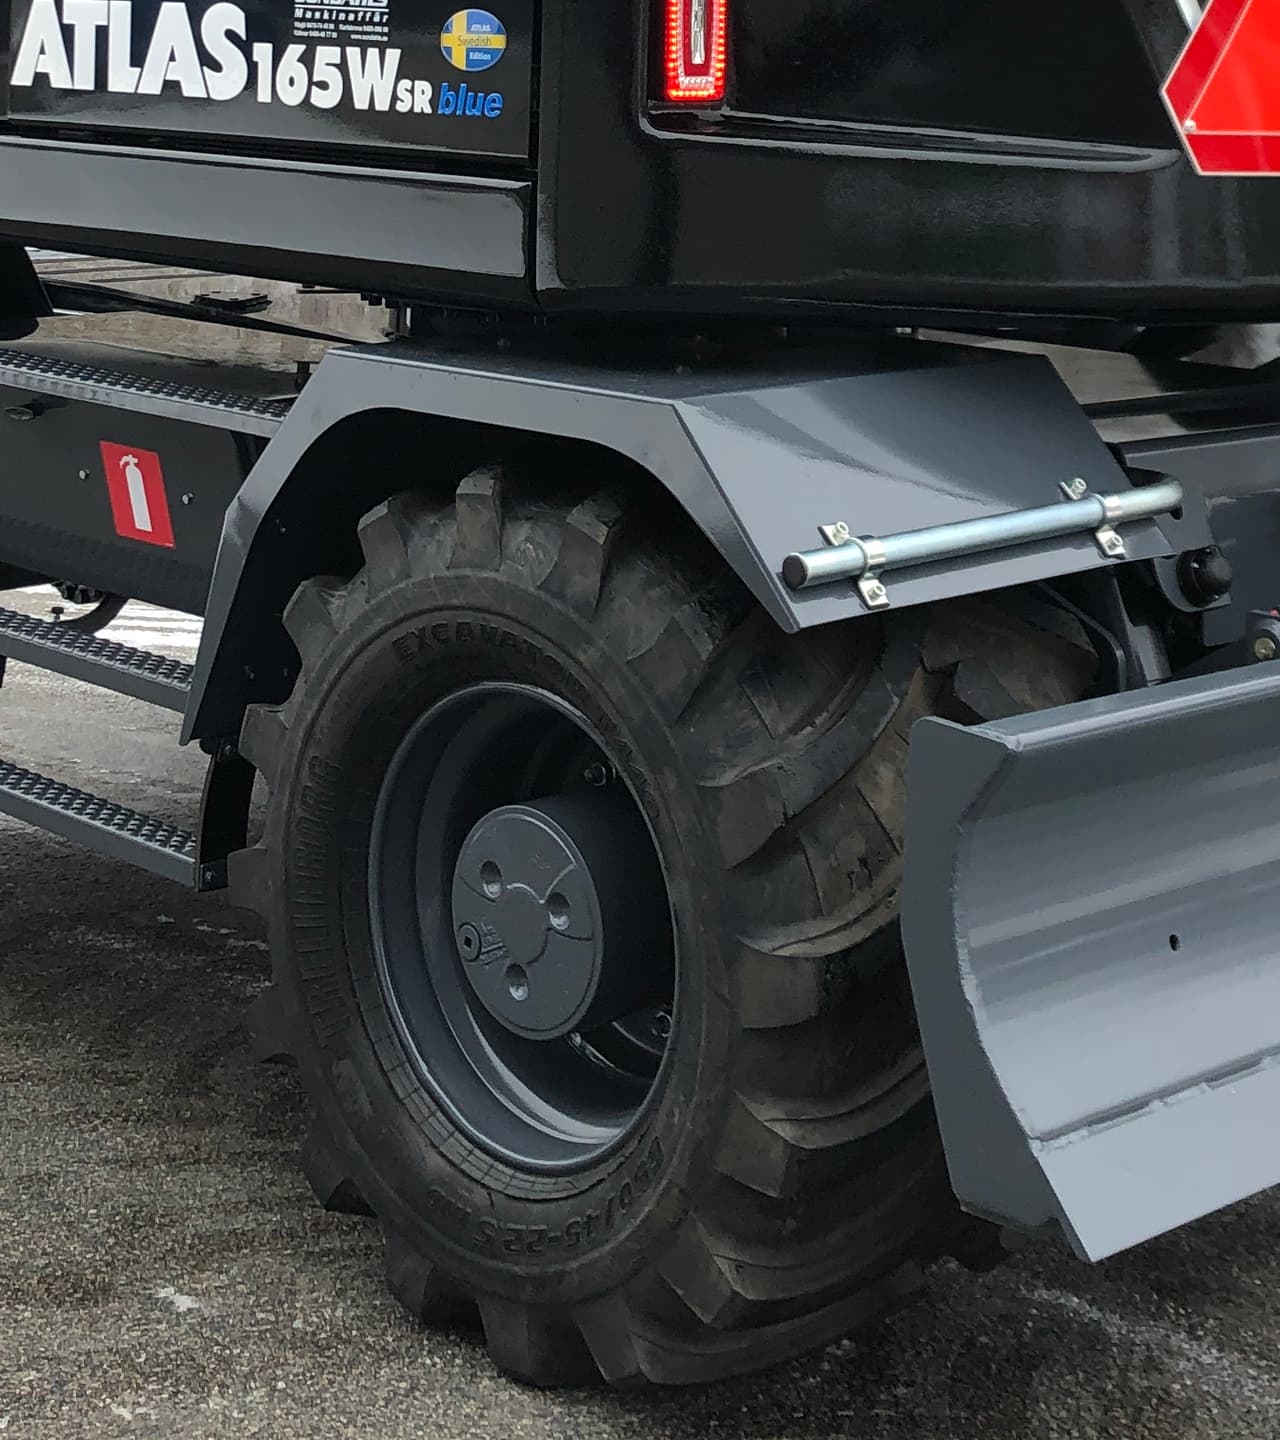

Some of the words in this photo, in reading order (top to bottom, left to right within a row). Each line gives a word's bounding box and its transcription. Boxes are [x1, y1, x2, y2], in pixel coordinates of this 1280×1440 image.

[294, 8, 389, 23] Maskinaffär
[458, 35, 491, 47] Swedish
[438, 83, 503, 118] blue
